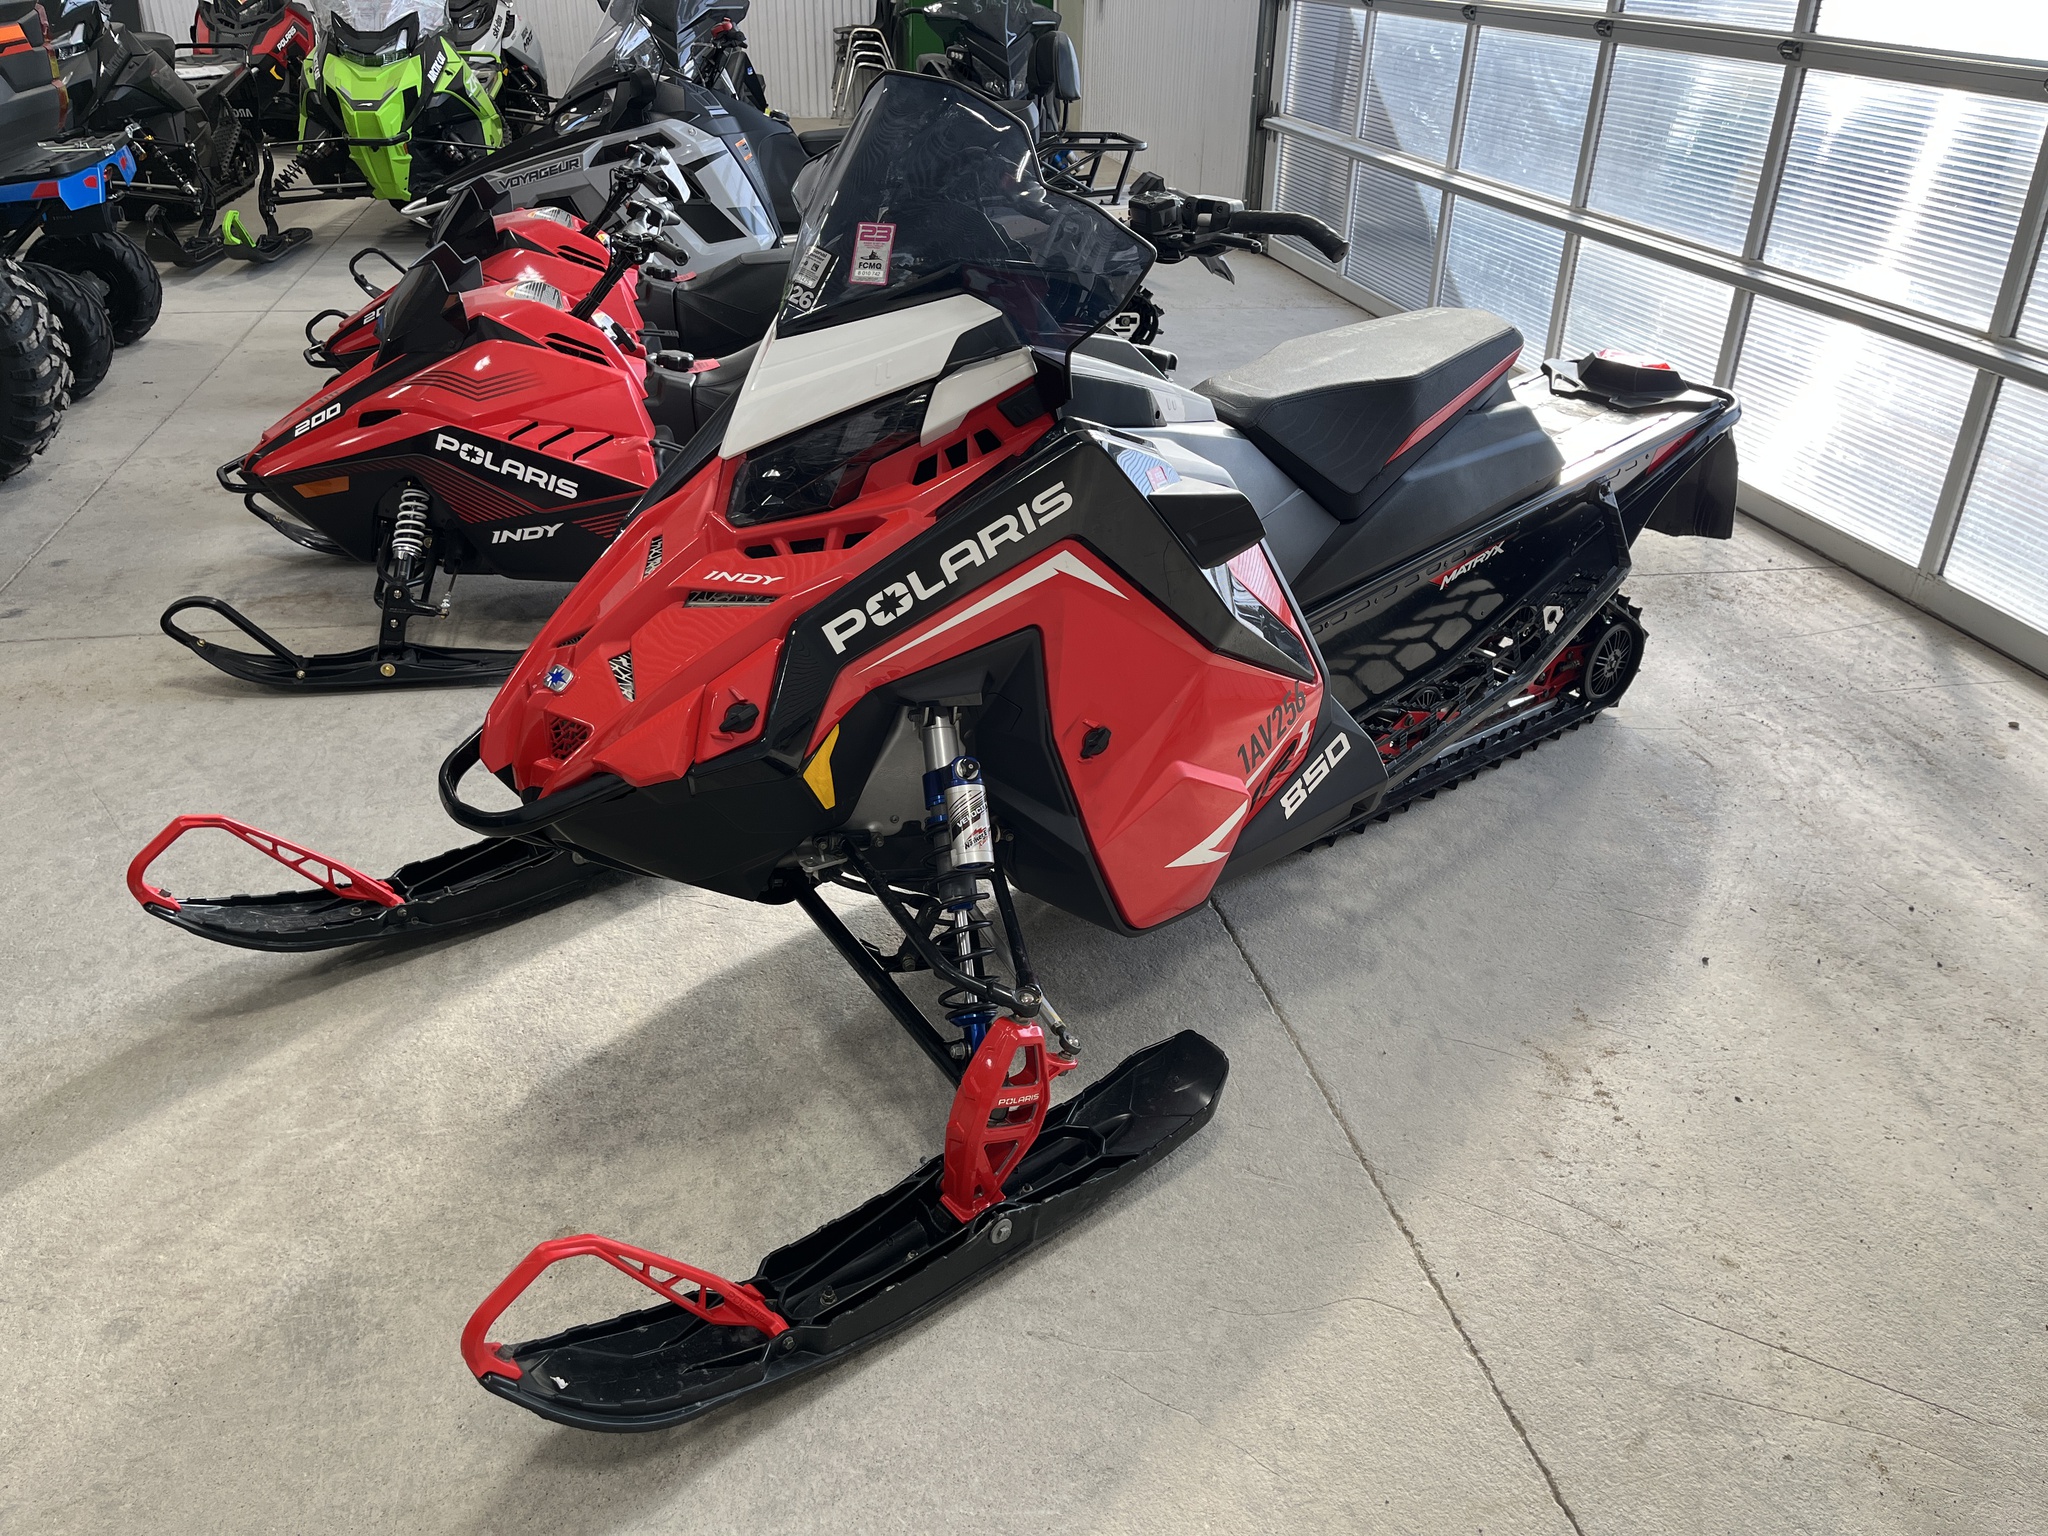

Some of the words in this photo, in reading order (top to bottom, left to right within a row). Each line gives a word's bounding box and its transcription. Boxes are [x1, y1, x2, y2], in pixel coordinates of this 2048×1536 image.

[277, 25, 297, 51] POLARIS
[427, 60, 443, 84] ARCTIC
[436, 51, 446, 66] CAT
[498, 157, 581, 190] VOYAGEUR
[860, 226, 892, 242] 23
[858, 262, 882, 270] FCMQ
[788, 285, 815, 309] 26
[294, 402, 341, 438] 200
[435, 433, 579, 499] POLARIS
[491, 522, 565, 544] INDY
[703, 570, 786, 585] INDY
[821, 480, 1073, 655] POLARIS
[1439, 540, 1506, 591] MATRYX
[1237, 680, 1307, 774] 1AV256
[1279, 731, 1352, 820] 850
[997, 1093, 1040, 1106] POLARIS
[727, 1291, 767, 1323] POLARIS
